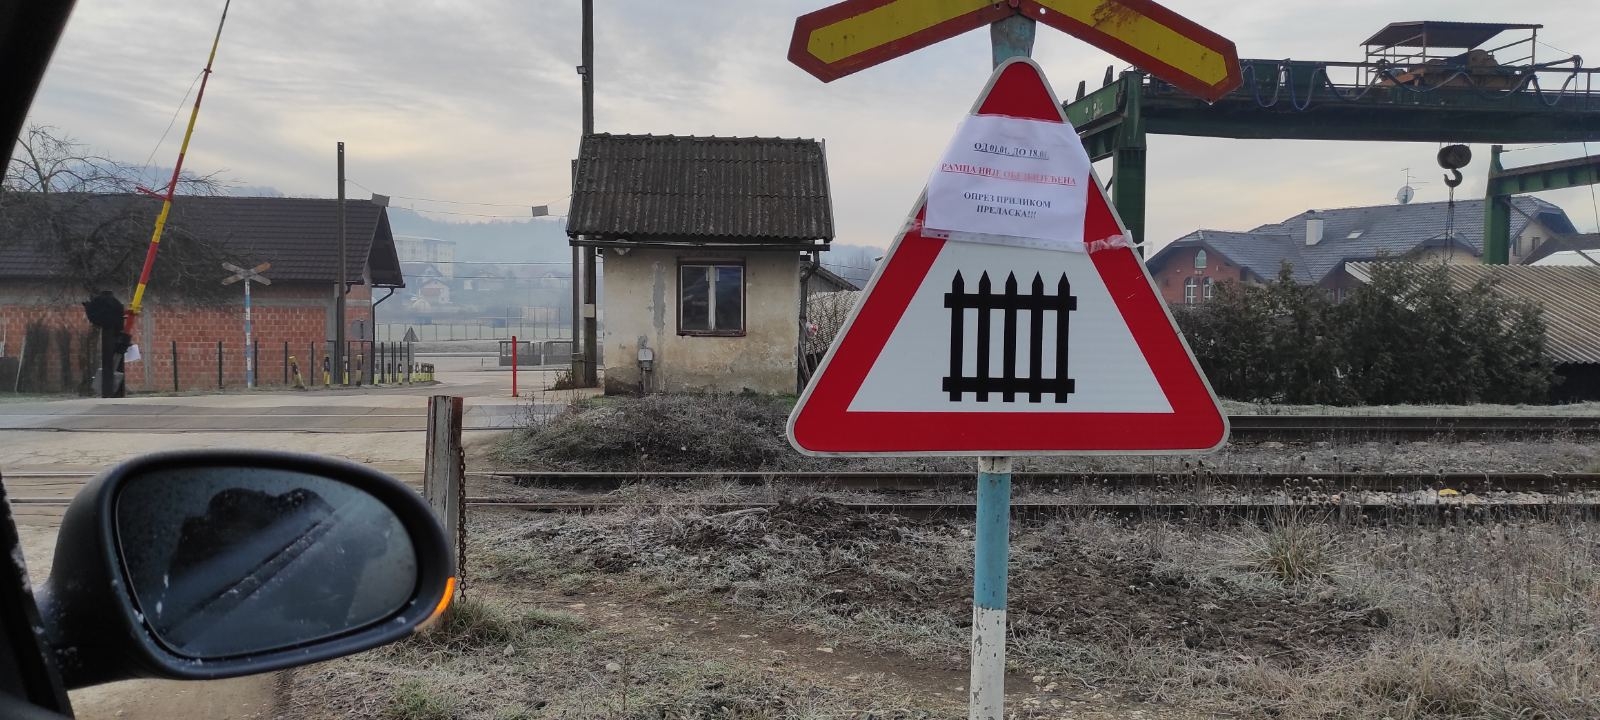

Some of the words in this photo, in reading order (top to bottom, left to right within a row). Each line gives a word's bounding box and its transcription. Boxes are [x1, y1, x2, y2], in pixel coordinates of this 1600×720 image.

[974, 142, 988, 153] ОД
[1012, 147, 1027, 157] ДО
[941, 163, 976, 175] РАМПА
[964, 191, 994, 203] ОПРЕЗ
[997, 195, 1051, 208] ПРИЛИКОМ
[976, 204, 1037, 218] ПРЕЛАСКА!!!
